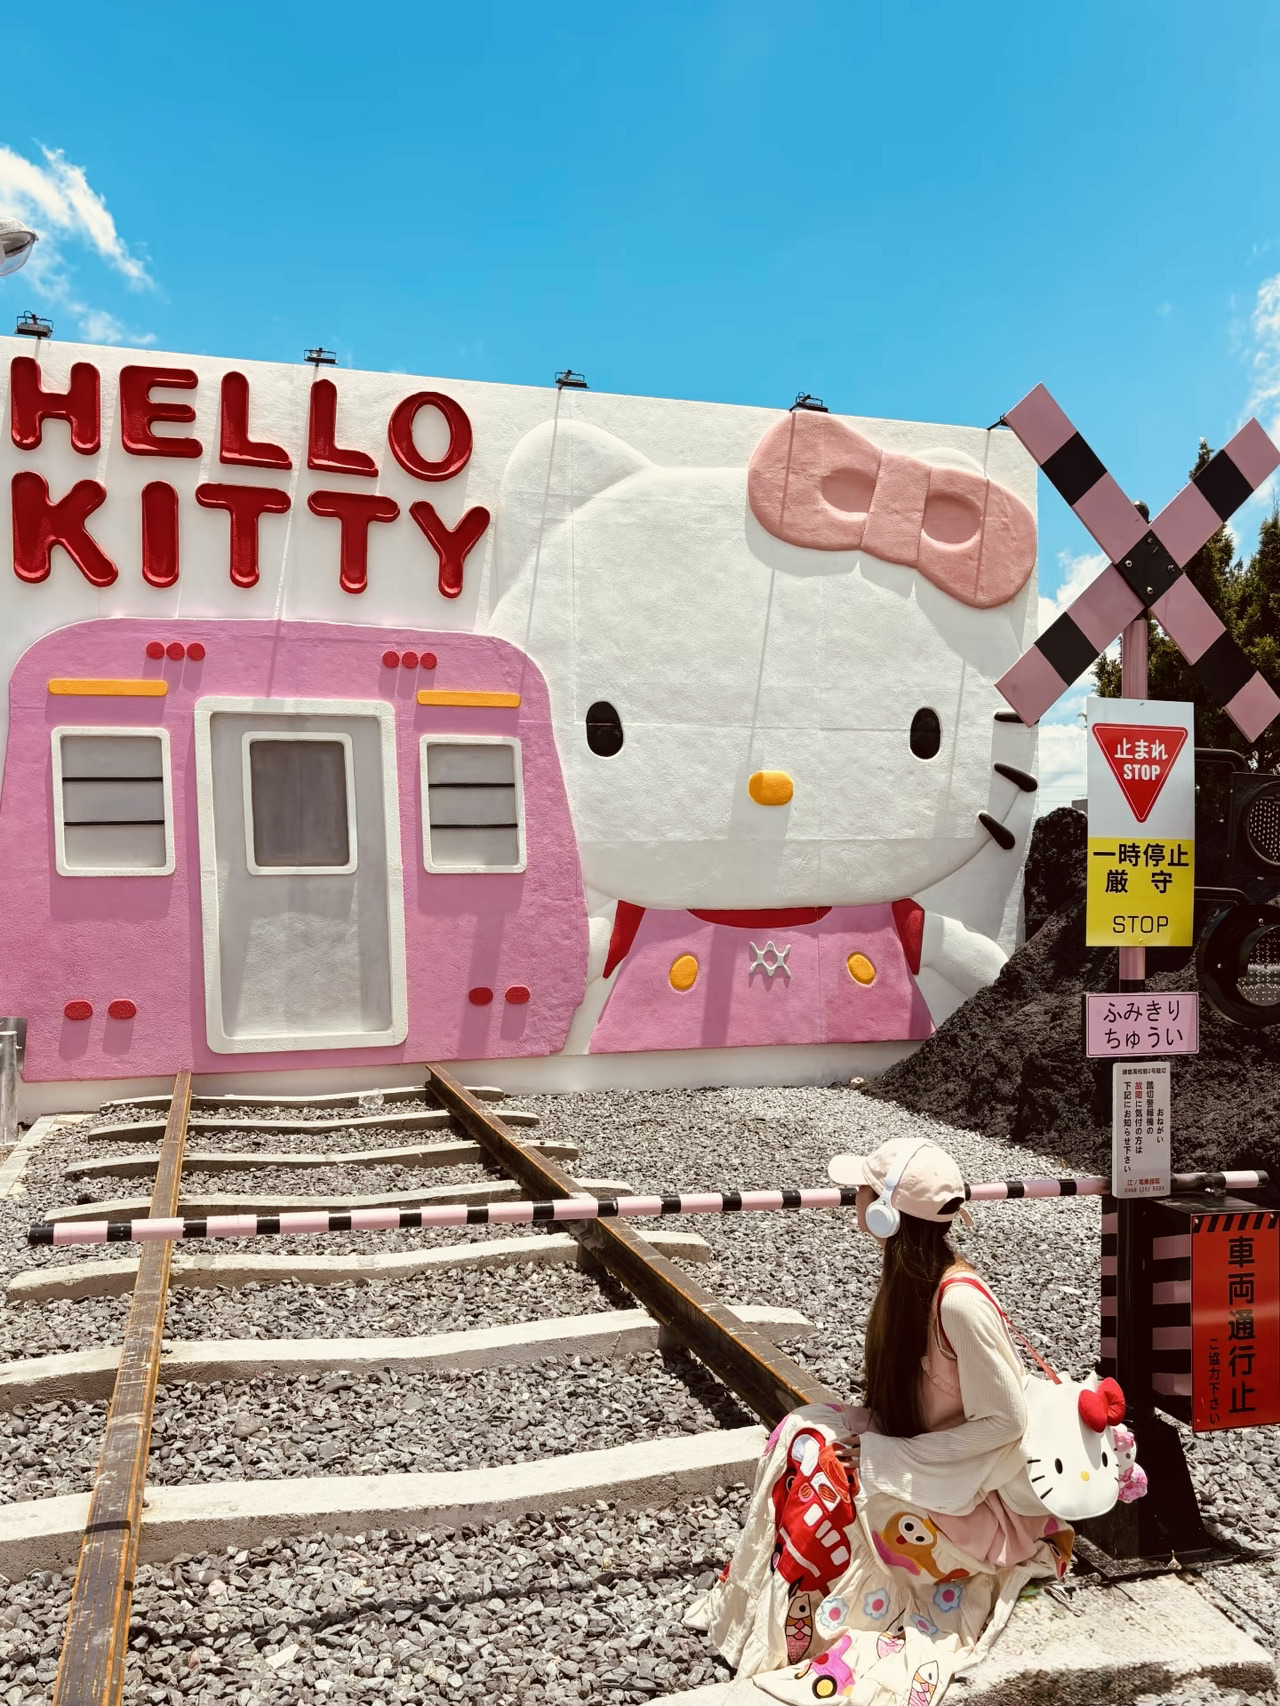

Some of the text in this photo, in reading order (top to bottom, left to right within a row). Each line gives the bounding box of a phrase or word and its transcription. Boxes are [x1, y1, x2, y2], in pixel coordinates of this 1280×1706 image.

[11, 356, 474, 482] HELLO
[11, 470, 491, 599] KITTY
[1114, 737, 1169, 761] 止まれ
[1123, 763, 1161, 781] STOP
[1092, 842, 1190, 868] 一時停止
[1112, 915, 1169, 934] STOP
[1103, 1000, 1181, 1023] ふみきり
[1104, 1026, 1183, 1050] ちゅうい
[1123, 1081, 1132, 1173] 下記にお知らせ下さい
[1156, 1108, 1164, 1144] おねがい
[1228, 1235, 1256, 1415] 車両通行止
